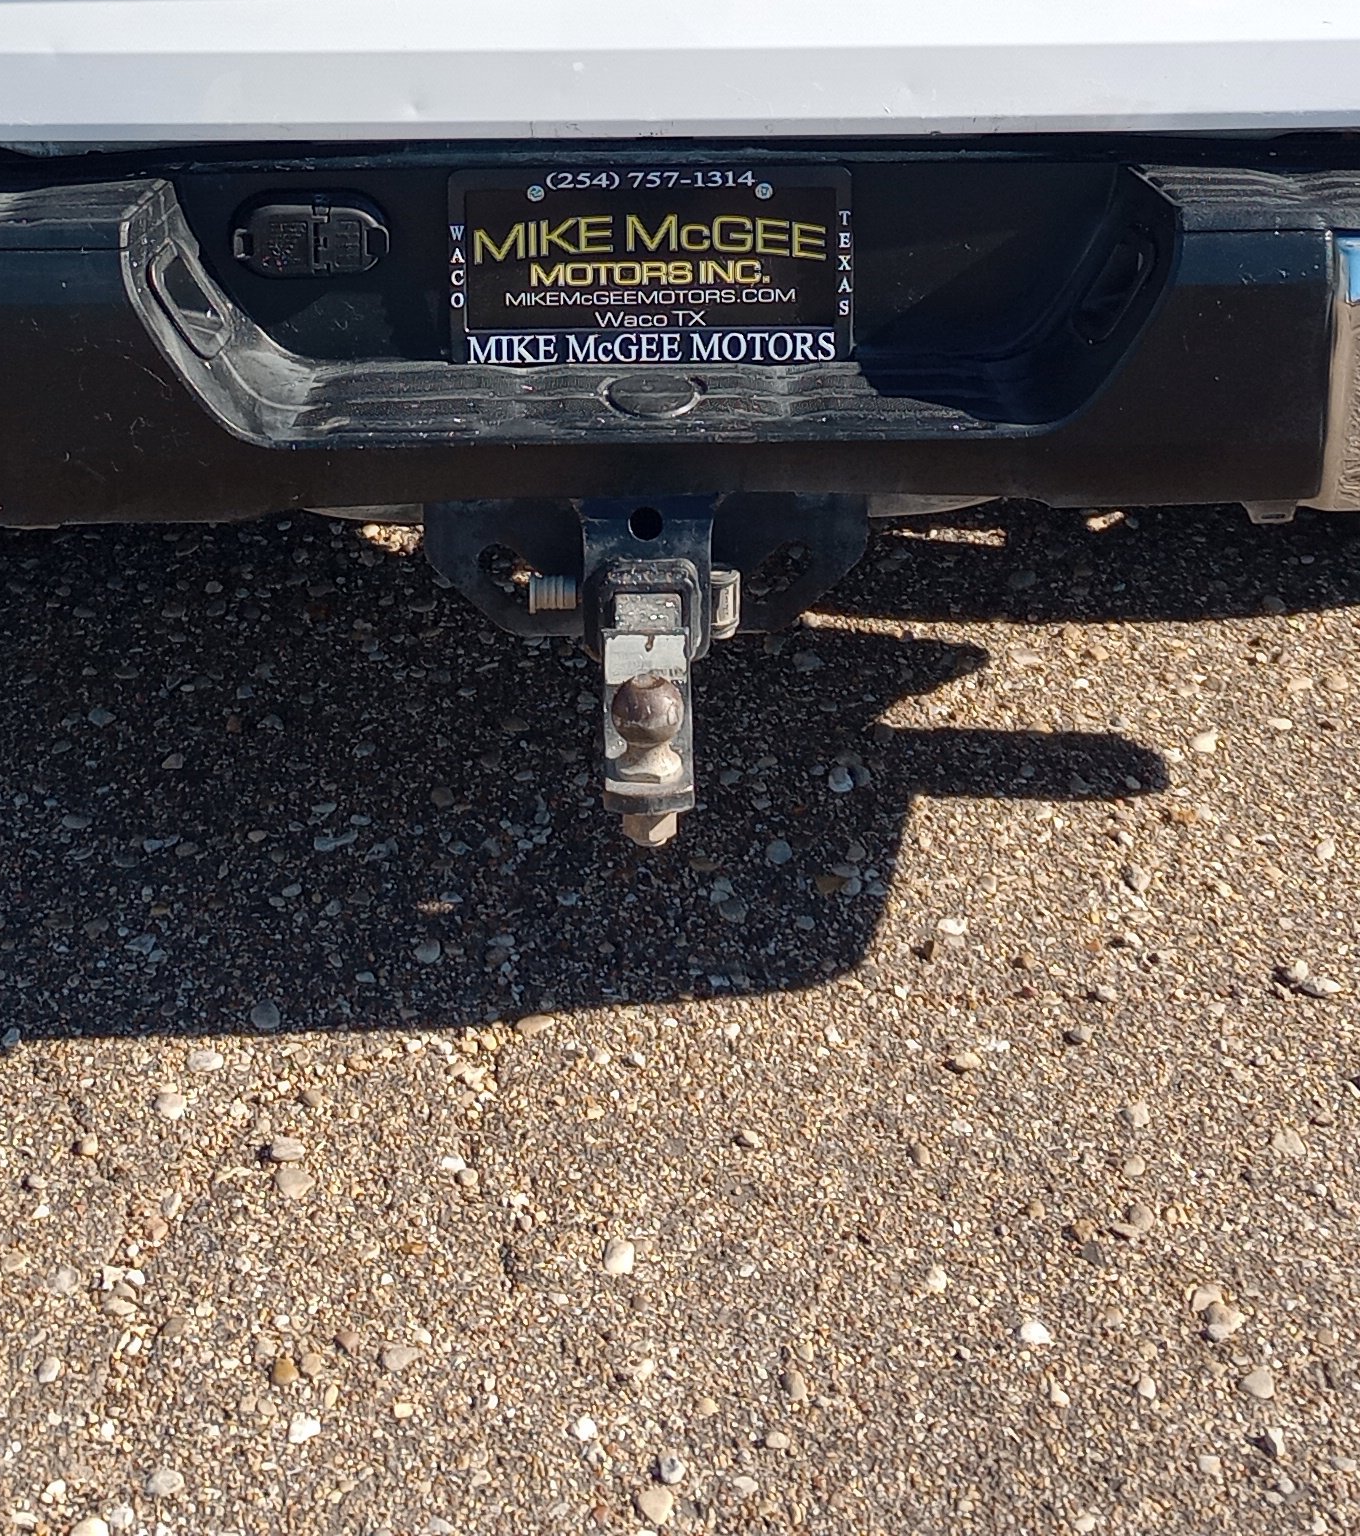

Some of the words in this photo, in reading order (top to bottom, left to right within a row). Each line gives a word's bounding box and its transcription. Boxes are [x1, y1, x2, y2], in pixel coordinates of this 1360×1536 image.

[545, 171, 620, 190] (254)
[627, 170, 756, 189] 757-1314
[473, 215, 614, 265] MIKE
[625, 213, 827, 262] McGEE
[449, 225, 465, 309] WACO
[529, 261, 693, 288] MOTORS
[699, 260, 771, 285] INC.
[838, 210, 853, 316] TEXAS
[505, 288, 796, 306] MIKEMcGEEMOTORS.COM
[594, 311, 669, 328] Waco
[671, 310, 707, 327] TX
[468, 335, 557, 364] MIKE
[566, 333, 681, 363] McGEE
[690, 330, 836, 362] MOTORS
